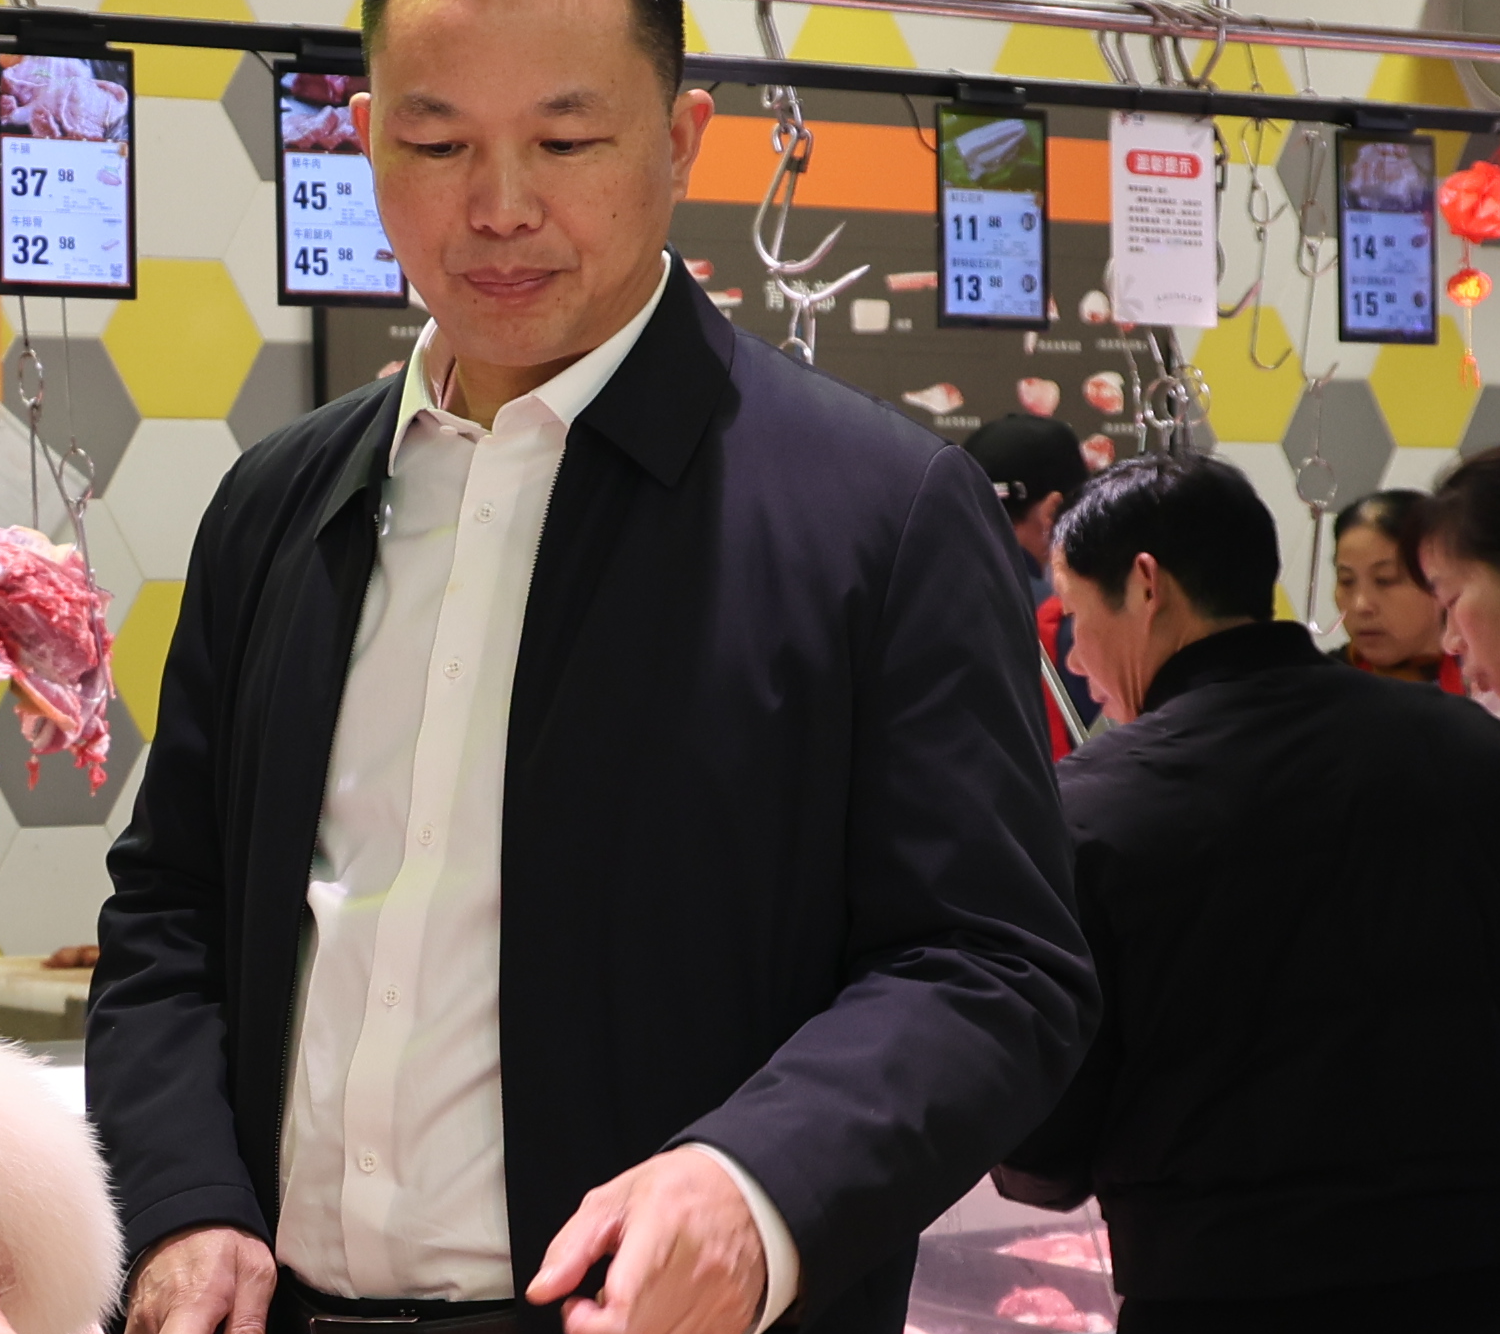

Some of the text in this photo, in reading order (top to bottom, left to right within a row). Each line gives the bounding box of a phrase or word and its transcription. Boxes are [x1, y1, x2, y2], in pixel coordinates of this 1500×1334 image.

[292, 157, 321, 169] 鲜牛肉
[58, 169, 74, 182] 98
[337, 182, 352, 195] 98
[59, 236, 75, 250] 98
[338, 248, 353, 261] 98
